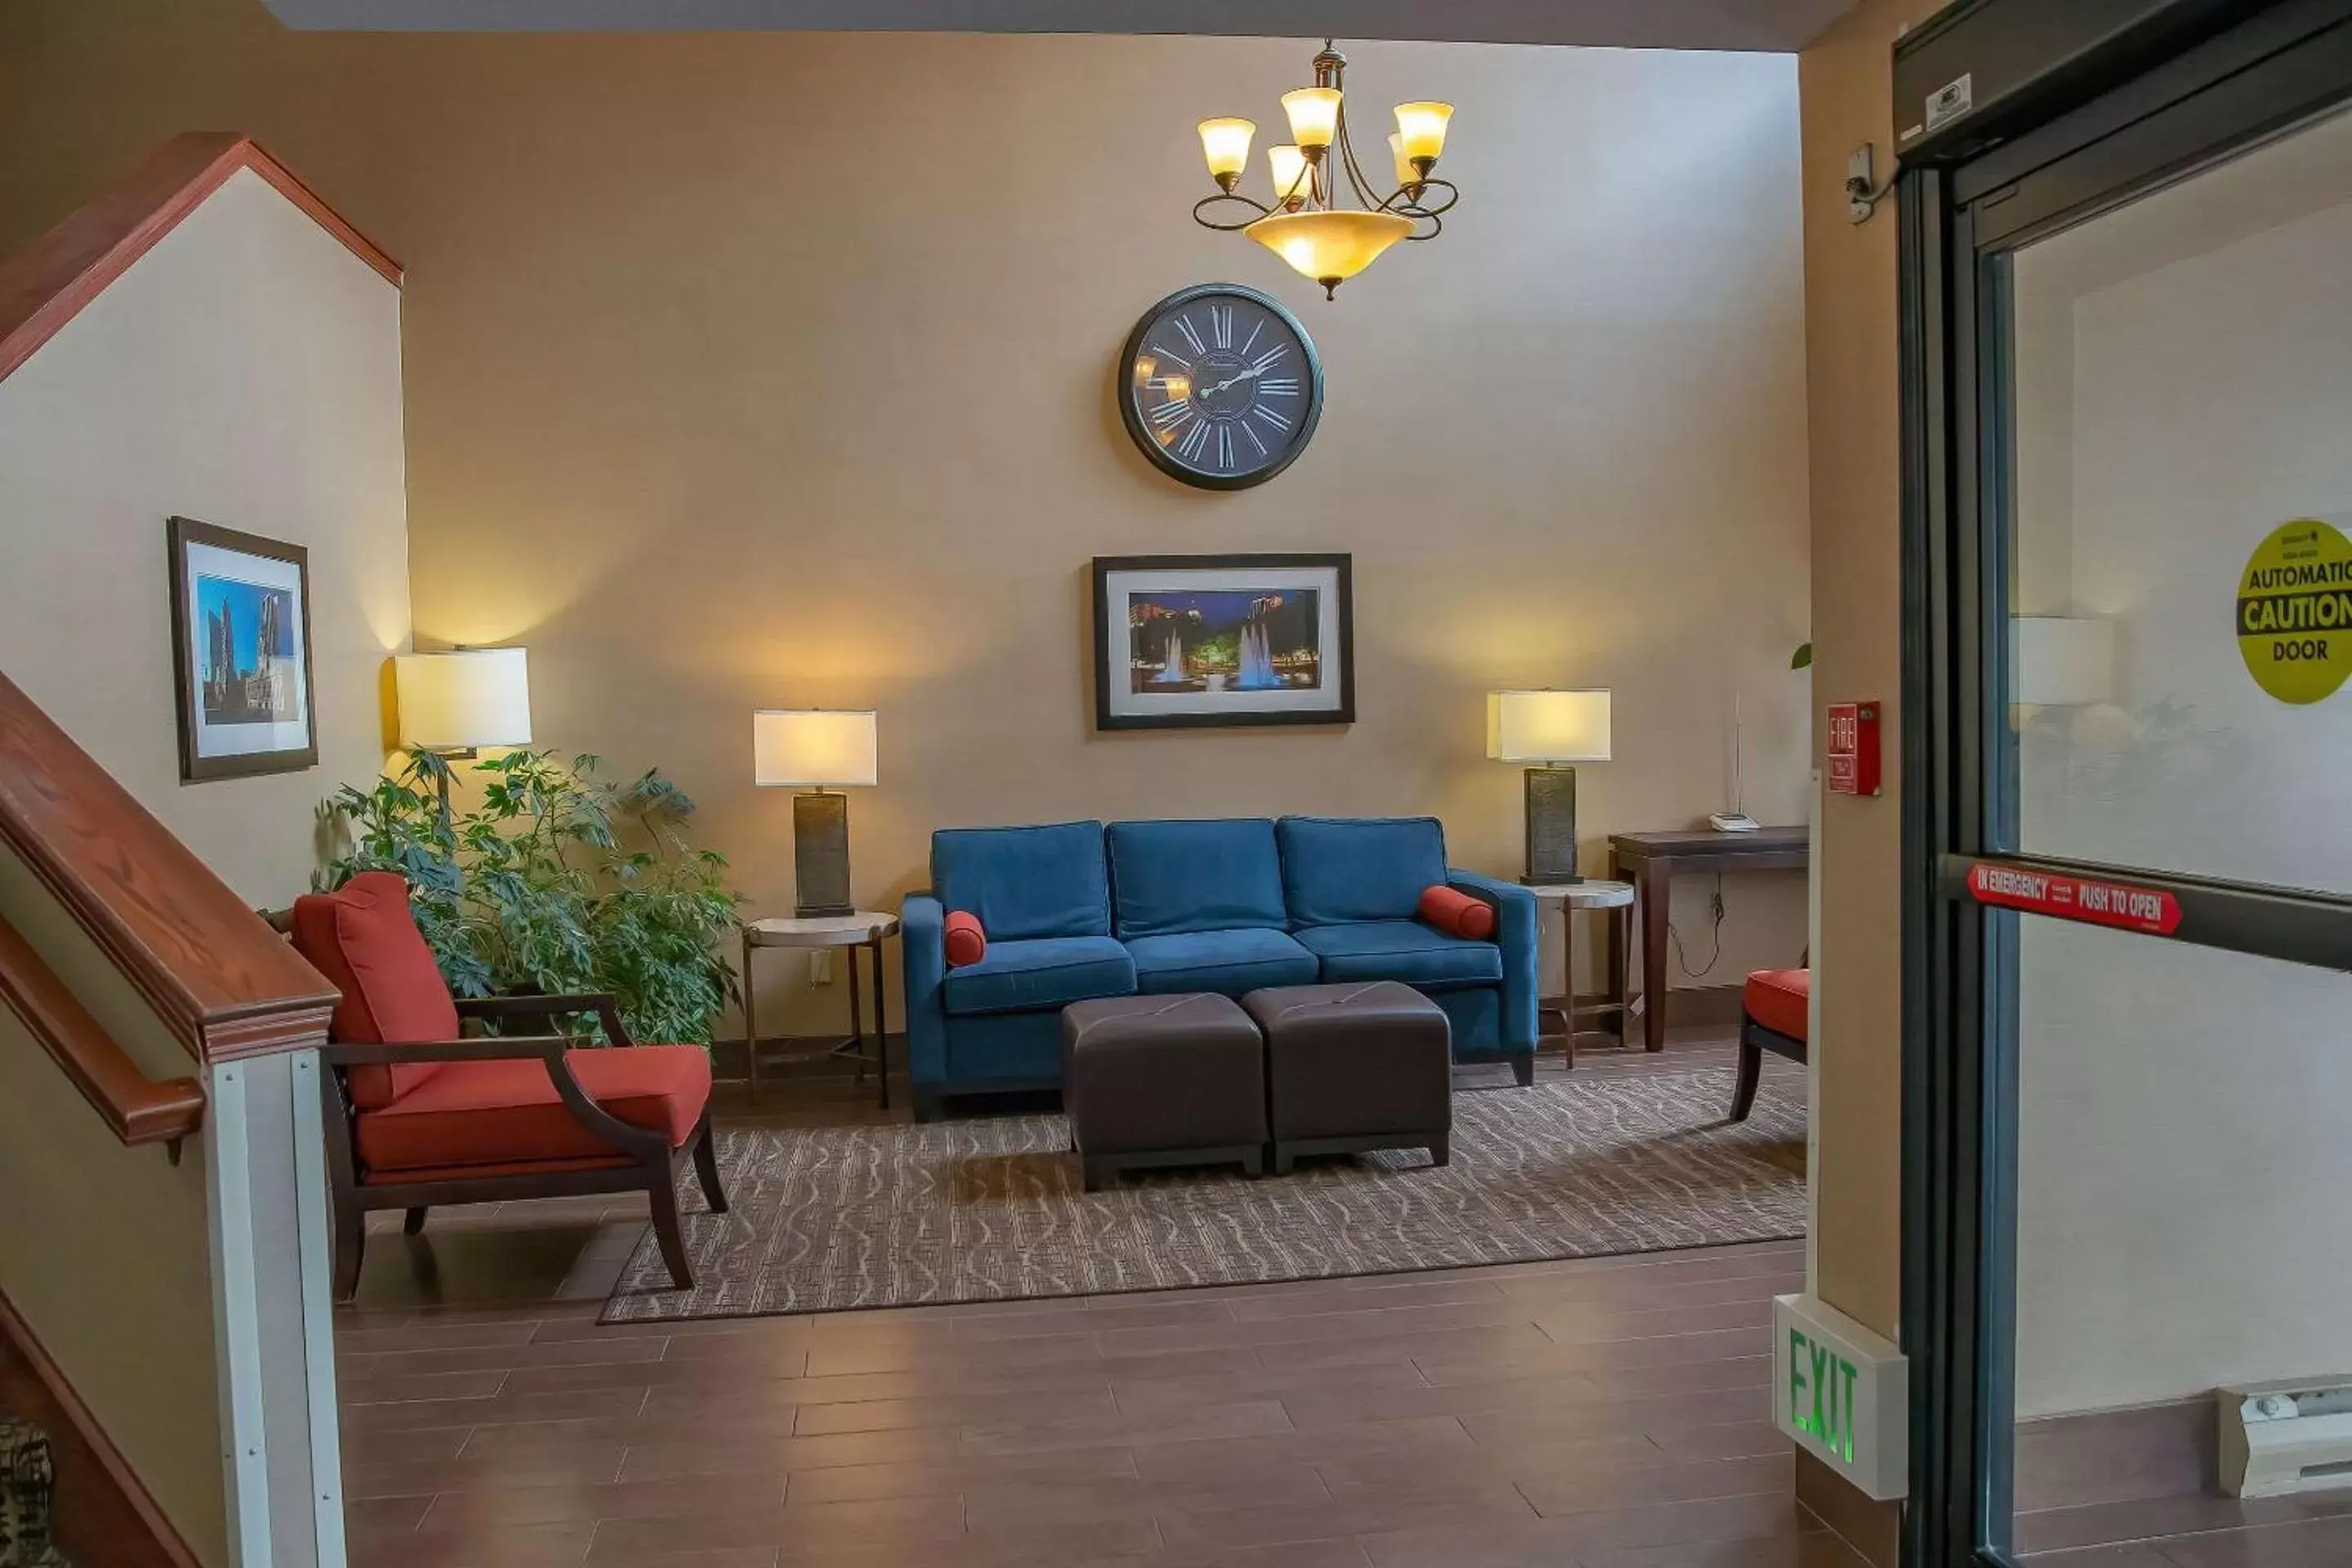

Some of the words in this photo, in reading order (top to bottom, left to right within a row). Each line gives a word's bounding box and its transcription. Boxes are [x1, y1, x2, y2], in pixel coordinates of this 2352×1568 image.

[2243, 593, 2352, 631] CAUTION
[2273, 639, 2328, 662] DOOR
[1830, 717, 1855, 750] FIRE
[1977, 868, 1989, 891] IN
[1989, 870, 2049, 901] EMERGENCY
[2078, 885, 2109, 912] PUSH
[2112, 891, 2127, 914] TO
[2130, 893, 2163, 921] OPEN
[1791, 1327, 1857, 1463] EXIT
